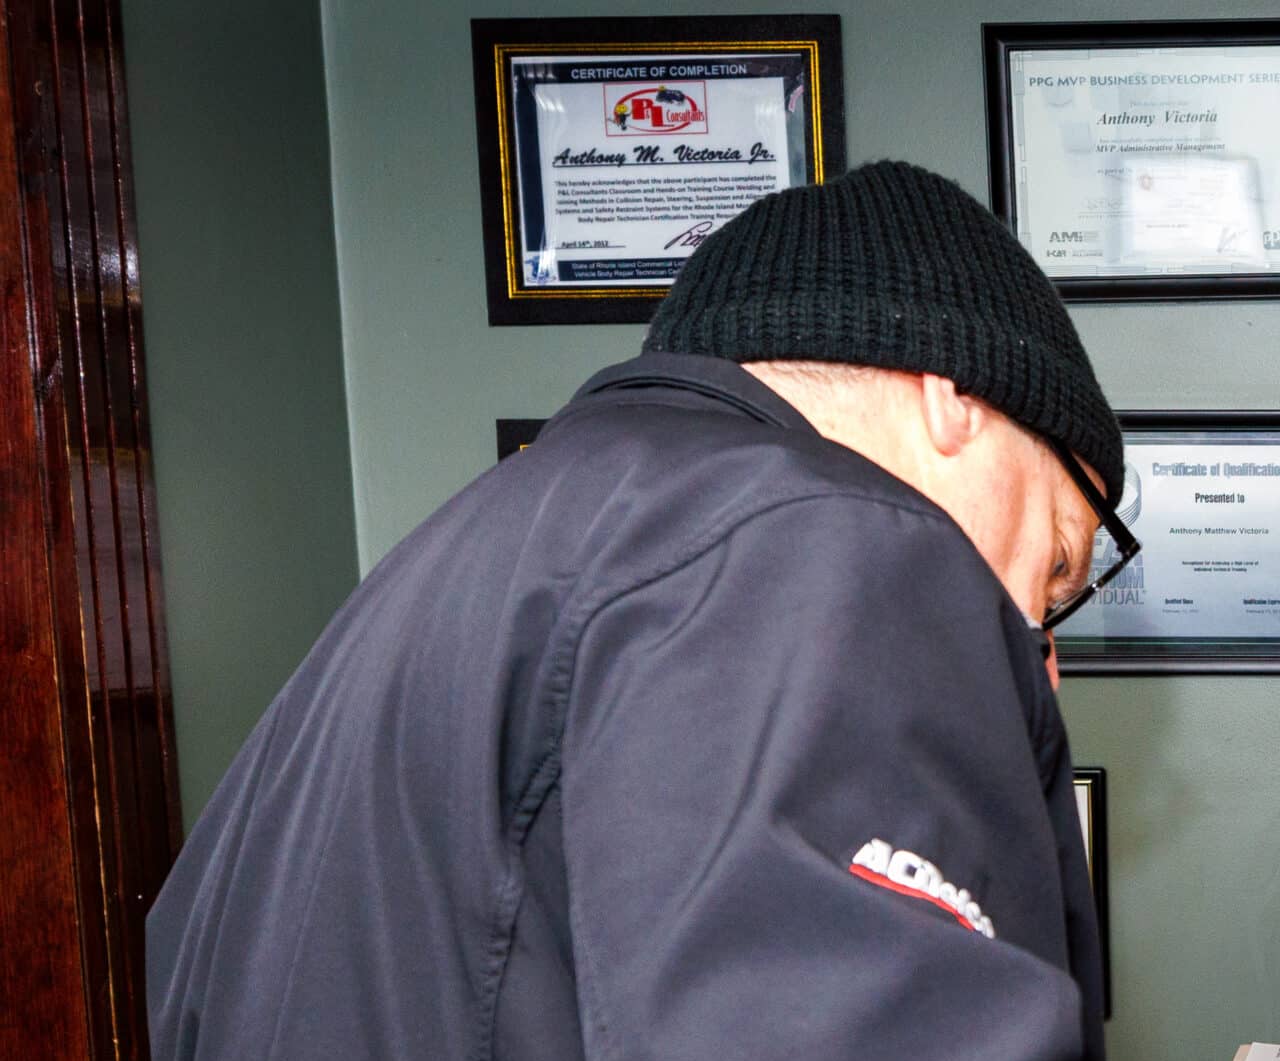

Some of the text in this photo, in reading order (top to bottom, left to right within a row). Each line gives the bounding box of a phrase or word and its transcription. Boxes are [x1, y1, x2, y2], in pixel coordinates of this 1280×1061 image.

[571, 64, 747, 79] CERTIFICATE OF COMPLETION
[1029, 77, 1054, 87] PPG
[1057, 76, 1087, 87] MVP
[1090, 75, 1147, 86] BUSINESS
[1151, 74, 1245, 85] DEVELOPMENT
[666, 109, 704, 123] Consultants
[1096, 109, 1218, 127] Anthony Victoria
[553, 142, 775, 165] Anthony M. Victoria Jr.
[1095, 143, 1226, 153] MVP Administrative Management
[592, 178, 635, 187] acknowledges
[684, 176, 717, 185] participant
[731, 175, 764, 183] completed
[688, 185, 712, 193] Training
[646, 205, 671, 213] Systems
[650, 213, 689, 221] Certification
[690, 213, 714, 221] Training
[561, 240, 577, 249] April
[637, 260, 673, 268] Commercial
[614, 269, 634, 277] Repair
[636, 268, 667, 276] Technician
[1152, 462, 1207, 477] Certificate
[1210, 462, 1221, 476] of
[1195, 492, 1245, 504] Presented to
[1169, 526, 1269, 537] Anthony Matthew Victoria
